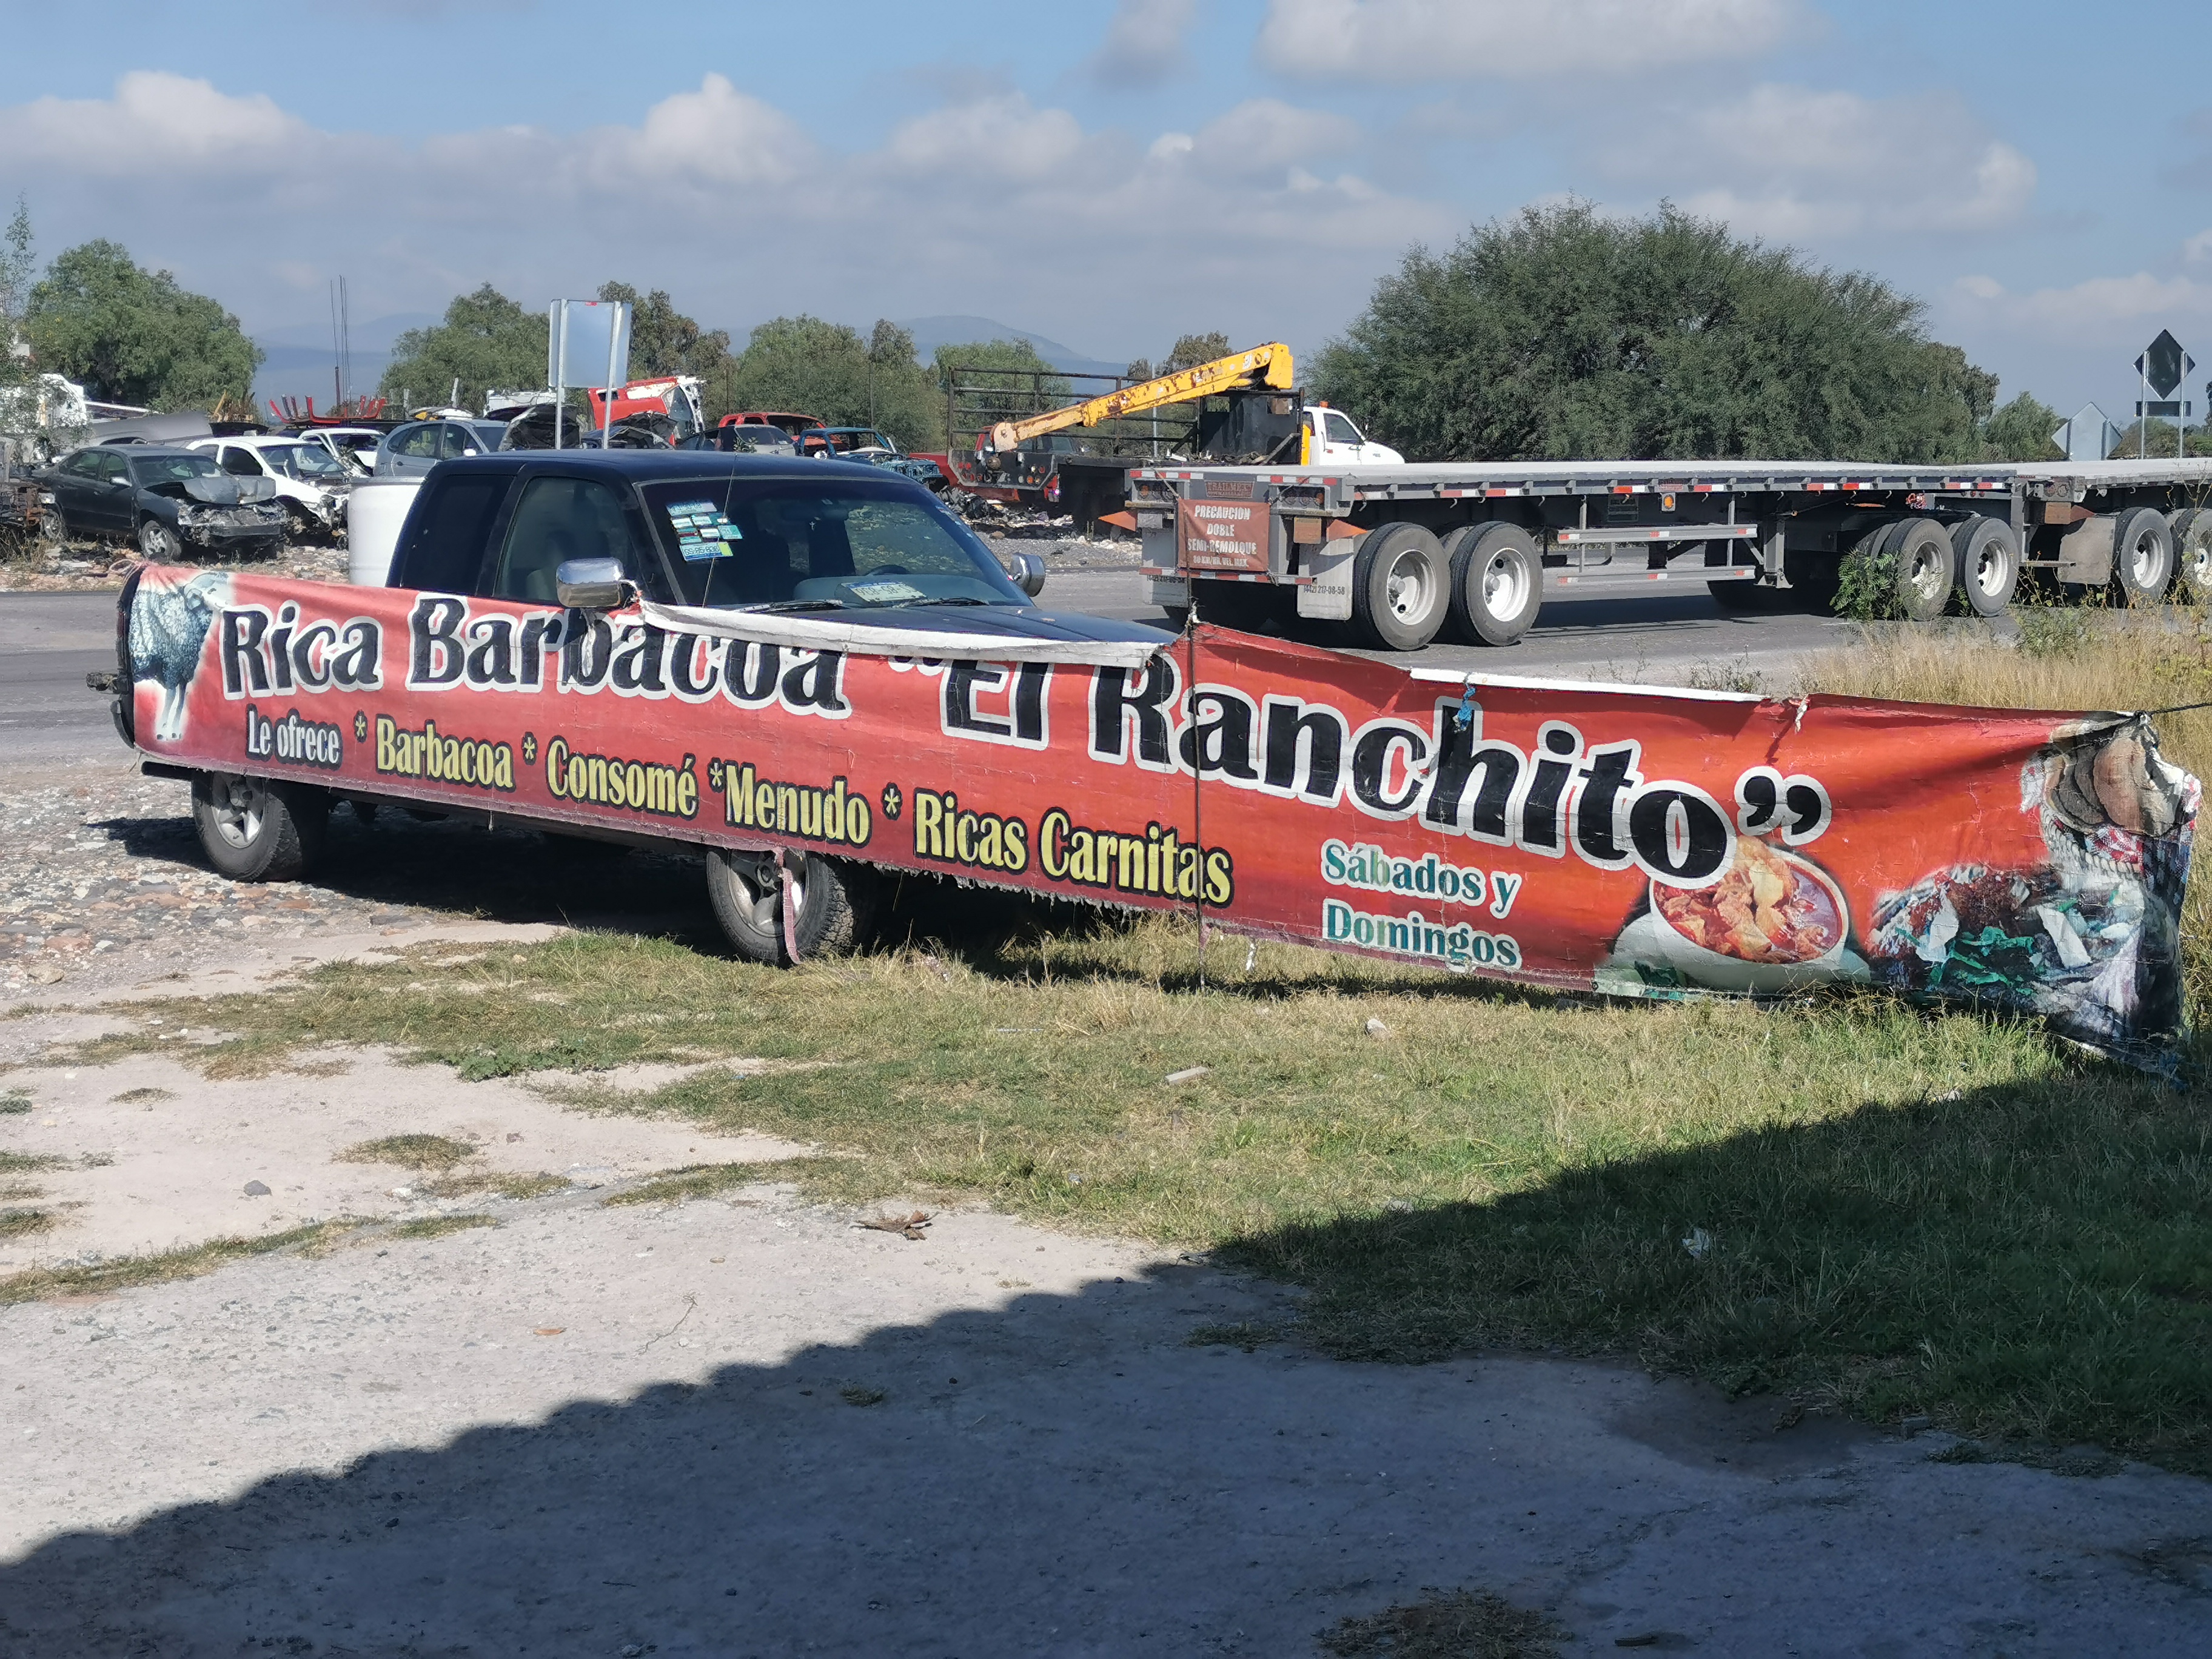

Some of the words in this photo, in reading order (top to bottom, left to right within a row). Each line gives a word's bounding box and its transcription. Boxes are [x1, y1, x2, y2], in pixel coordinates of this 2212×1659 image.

[1187, 538, 1257, 555] SEMI-REMOLQUE
[1194, 505, 1251, 520] PRECAUCION
[1206, 523, 1235, 537] DOBLE
[221, 600, 382, 698] Rica
[407, 594, 850, 717] Barbacoa
[247, 706, 273, 757] Le
[276, 711, 341, 766] ofrece
[375, 716, 515, 789] Barbacoa
[546, 738, 699, 817] Consomé
[724, 762, 871, 846] Menudo
[913, 790, 1027, 873] Ricas
[1039, 809, 1233, 906] Carnitas
[1322, 839, 1485, 907] Sábados
[1491, 871, 1521, 918] y
[1322, 899, 1522, 971] Domingos
